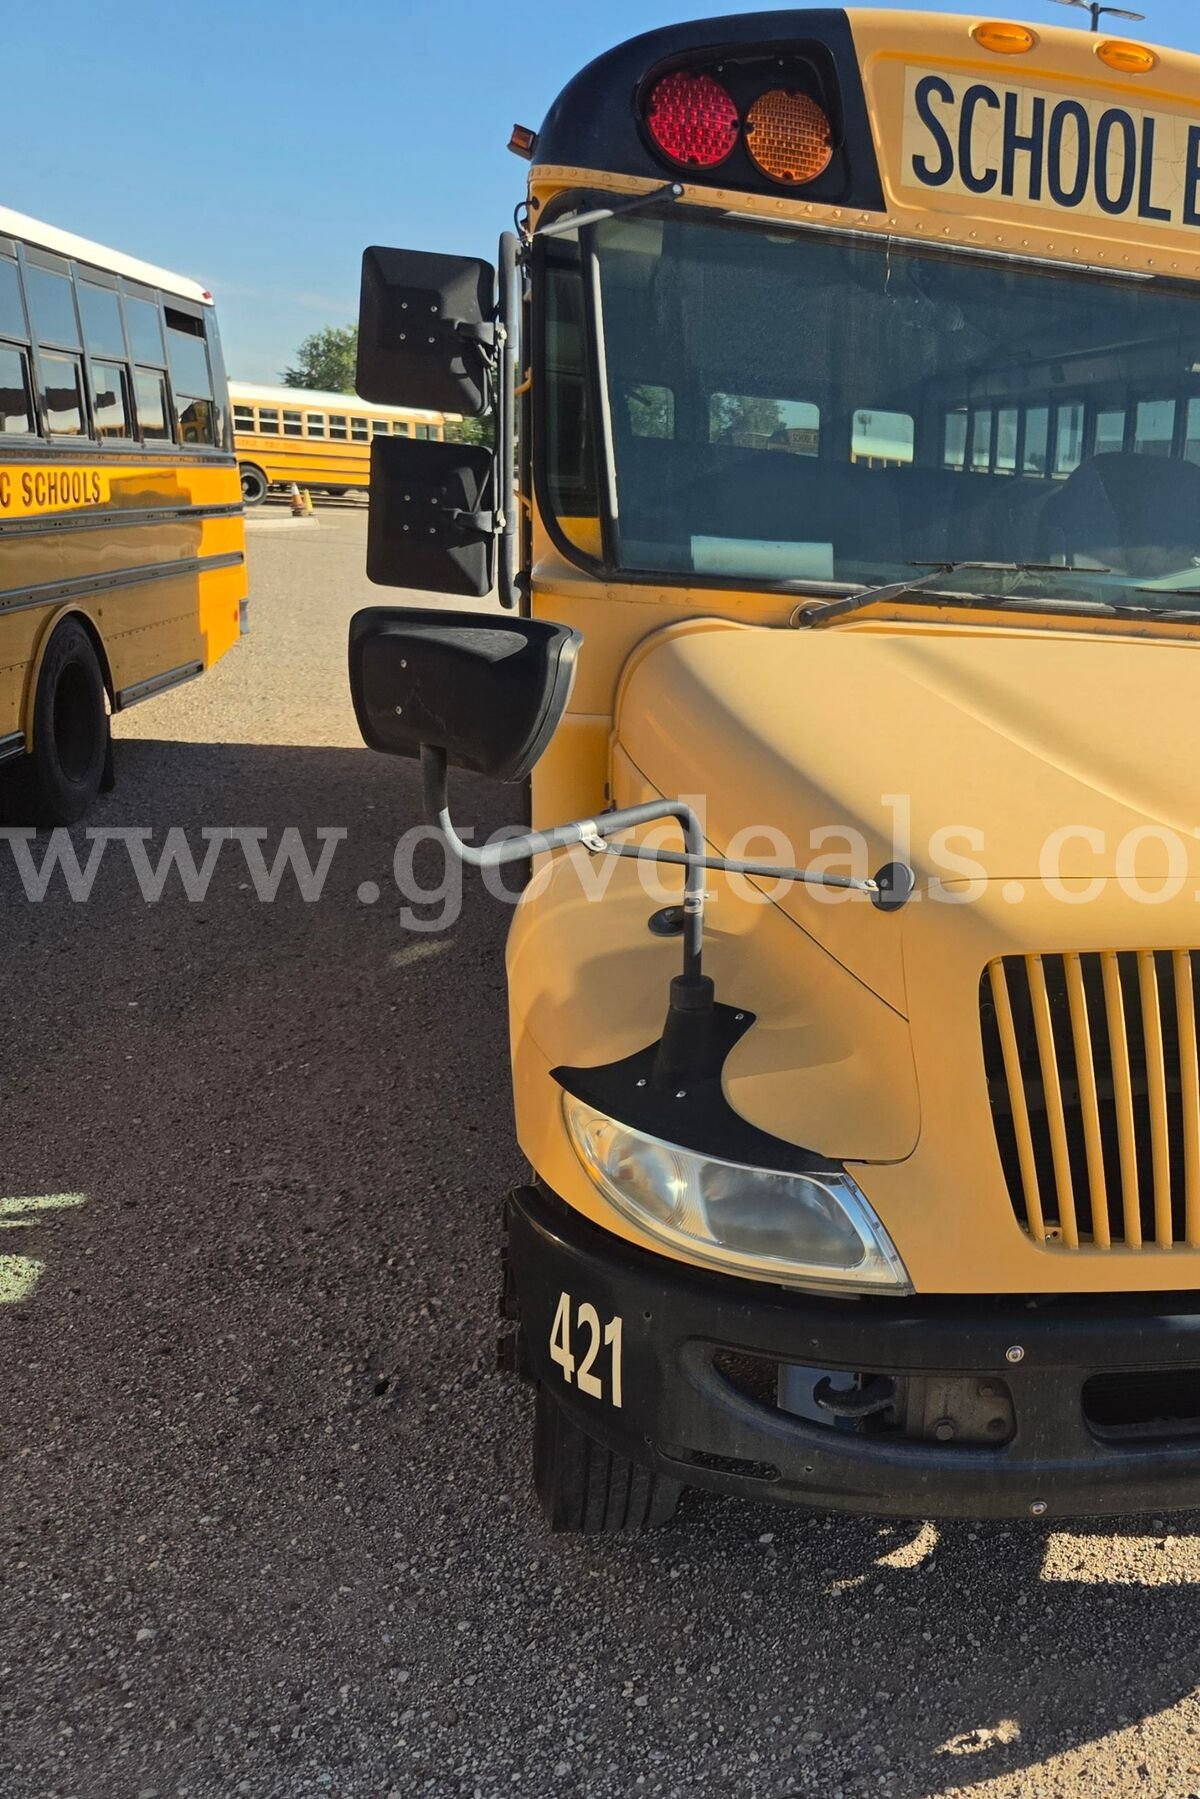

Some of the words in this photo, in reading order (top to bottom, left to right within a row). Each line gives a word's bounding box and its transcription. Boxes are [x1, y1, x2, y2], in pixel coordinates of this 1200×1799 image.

[912, 75, 1171, 222] SCHOOL
[22, 471, 100, 507] SCHOOLS
[550, 1291, 622, 1408] 421
